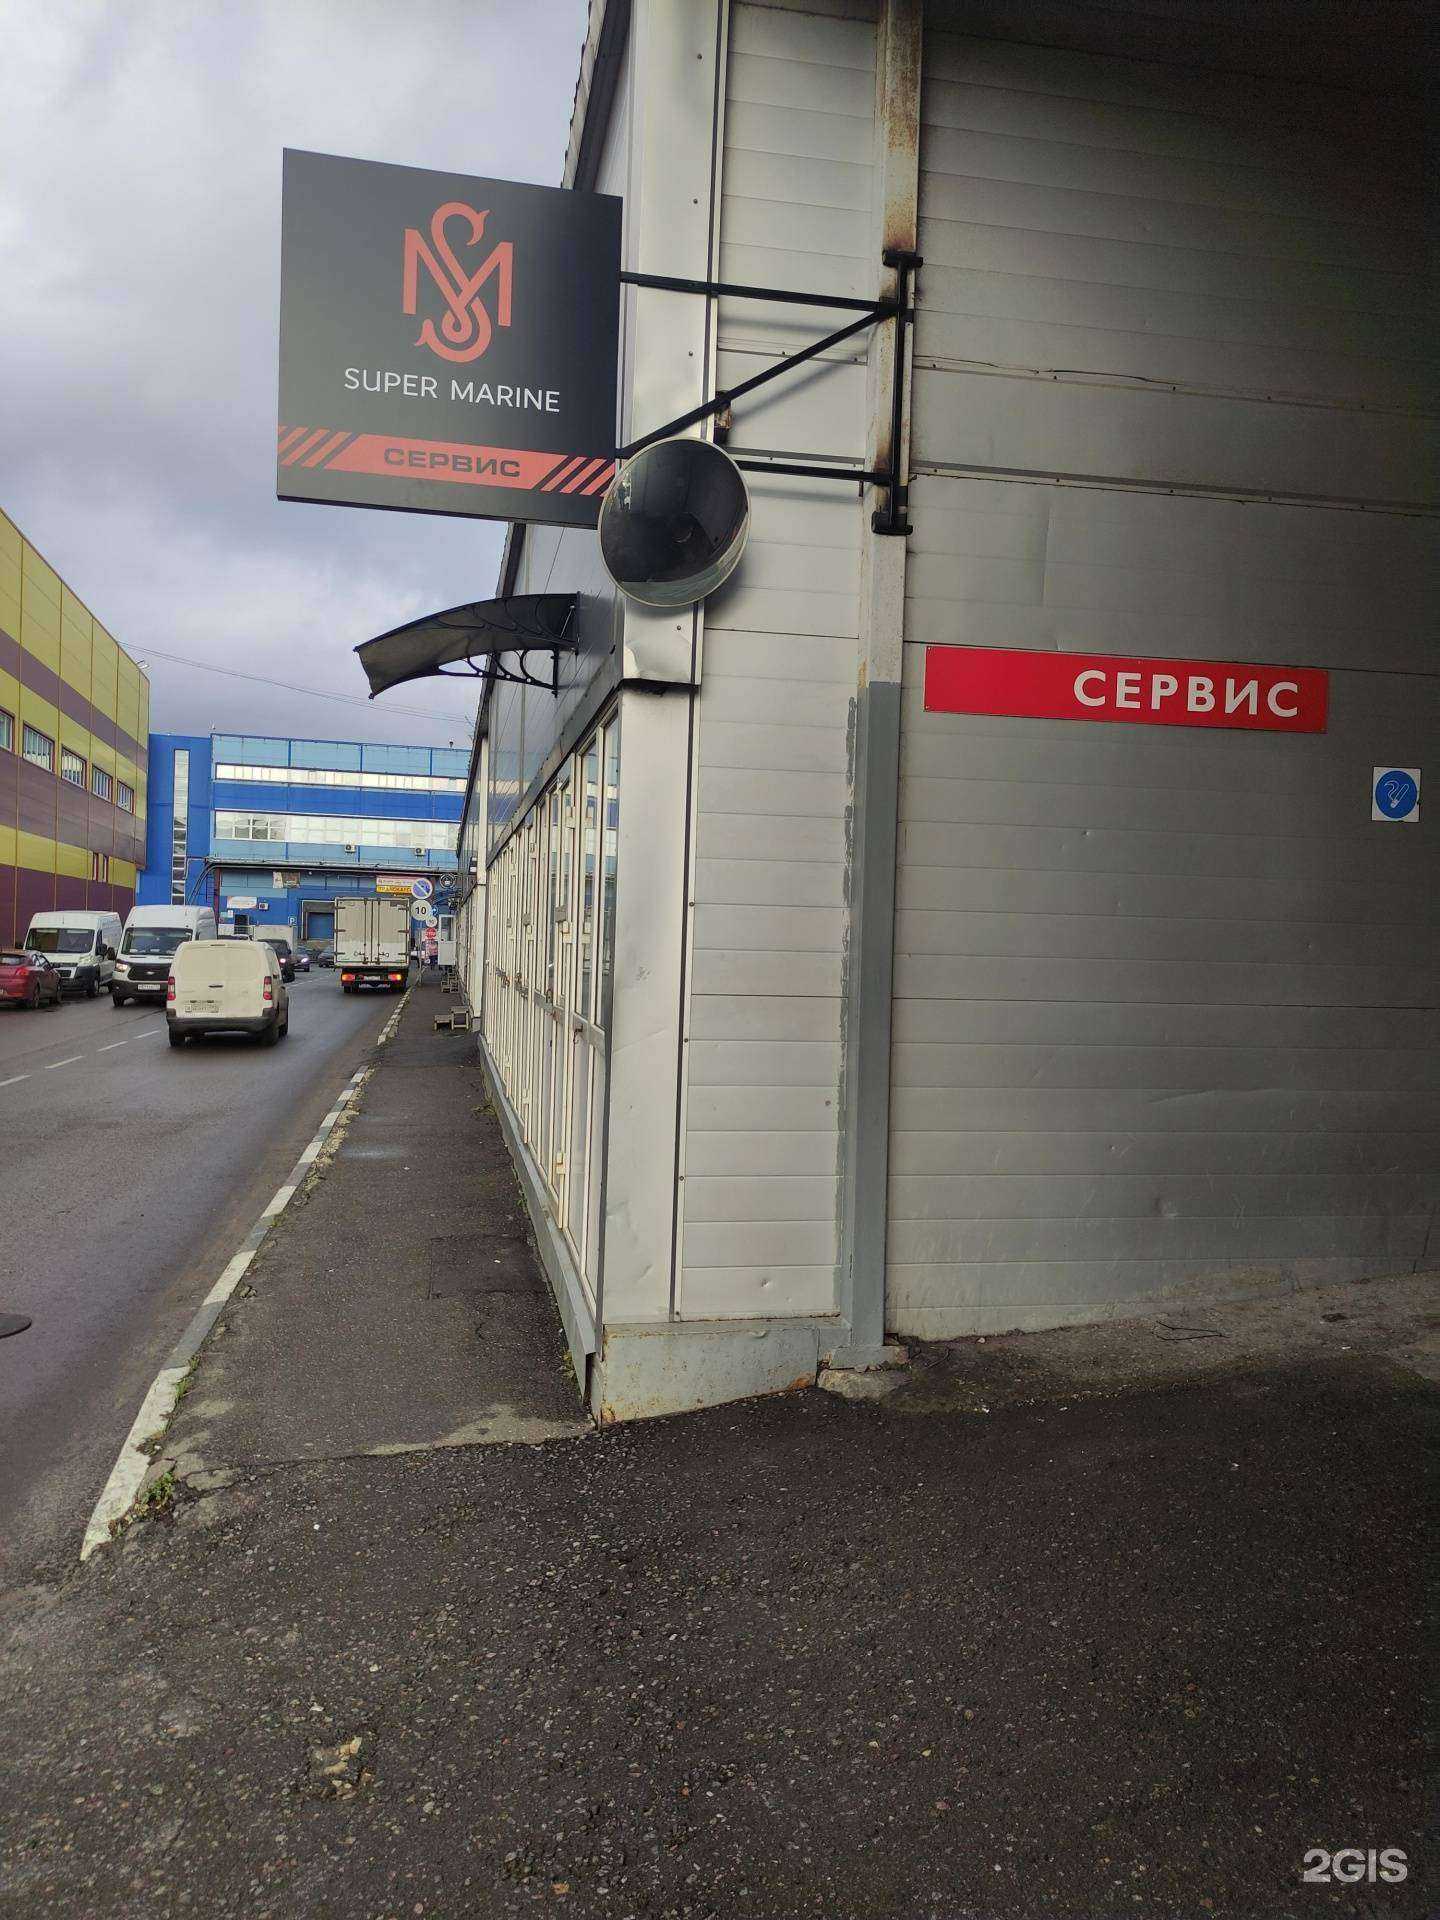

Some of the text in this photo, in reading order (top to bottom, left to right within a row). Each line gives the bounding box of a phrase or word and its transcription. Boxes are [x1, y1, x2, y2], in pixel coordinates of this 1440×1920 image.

[343, 366, 561, 414] SUPER MARINE
[383, 447, 521, 478] СЕРВИС
[1073, 669, 1299, 718] СЕРВИС
[415, 906, 427, 915] 10
